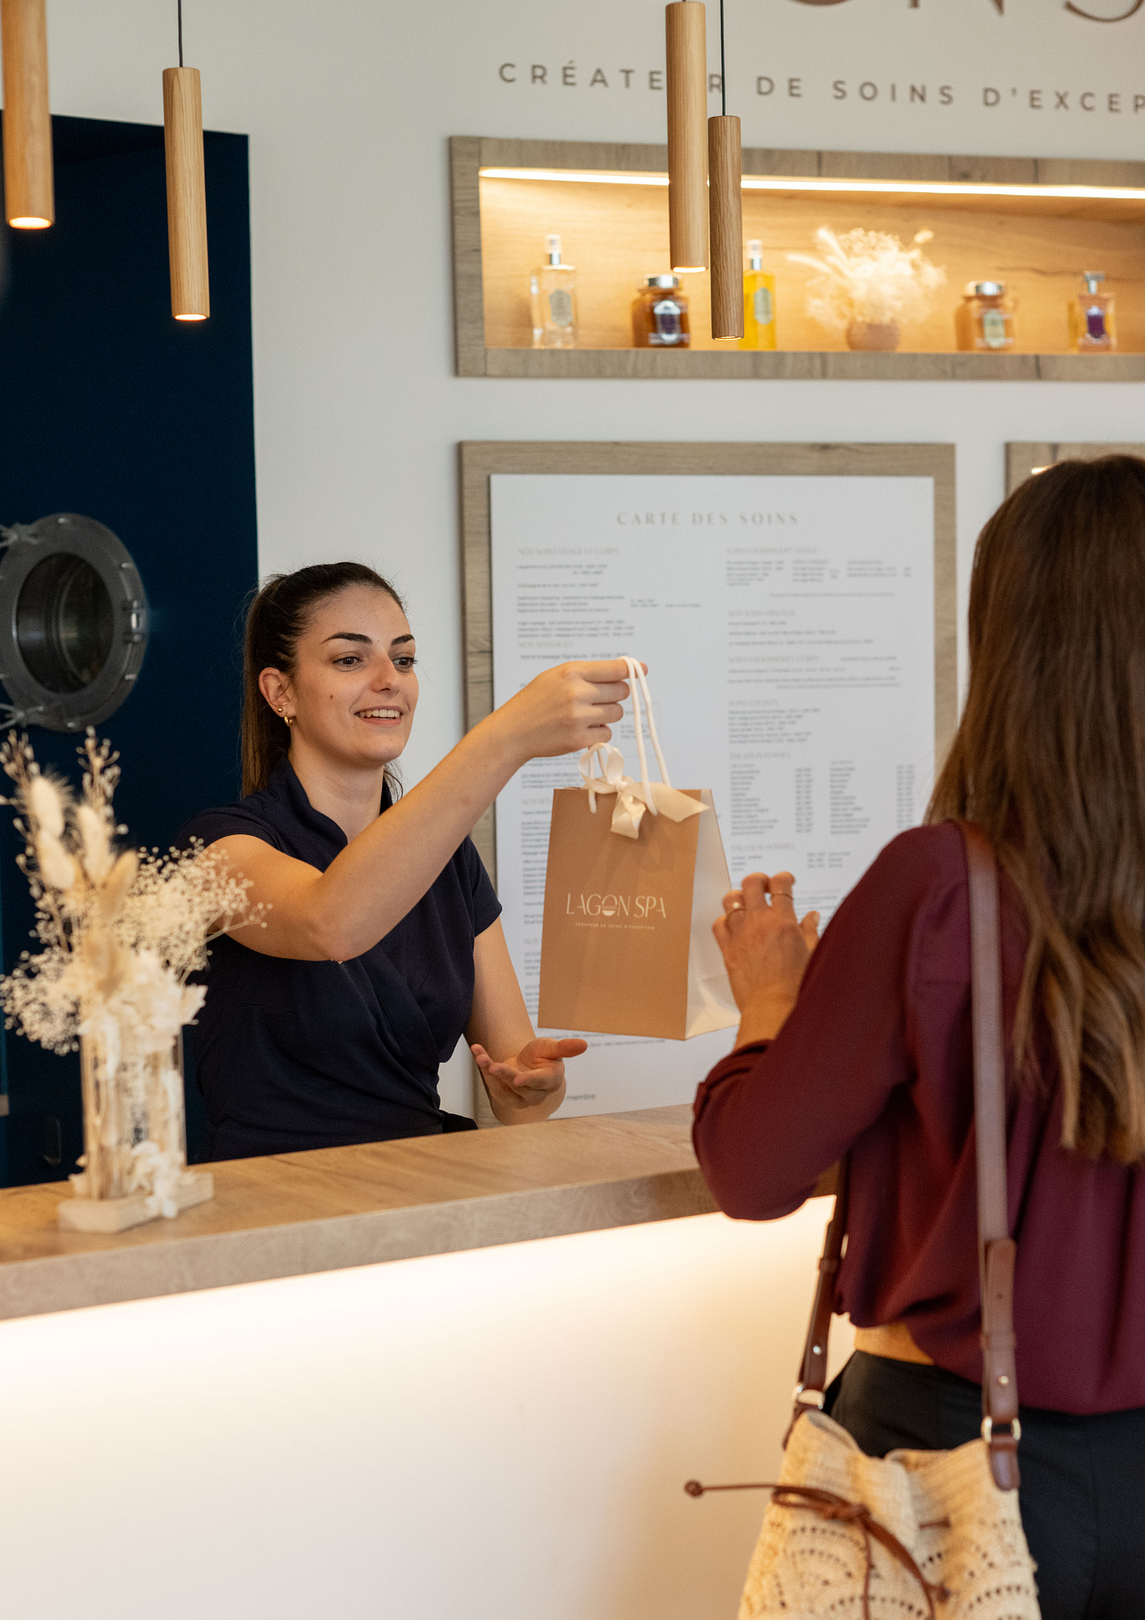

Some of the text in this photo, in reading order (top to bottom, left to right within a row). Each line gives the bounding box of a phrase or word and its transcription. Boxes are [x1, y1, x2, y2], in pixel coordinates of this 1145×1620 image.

[498, 60, 723, 93] CRÉATER
[756, 76, 802, 98] DE
[833, 80, 954, 105] SOINS
[616, 512, 799, 526] CARTE DES SOINS
[566, 893, 631, 917] LAGON
[634, 895, 667, 919] SPA
